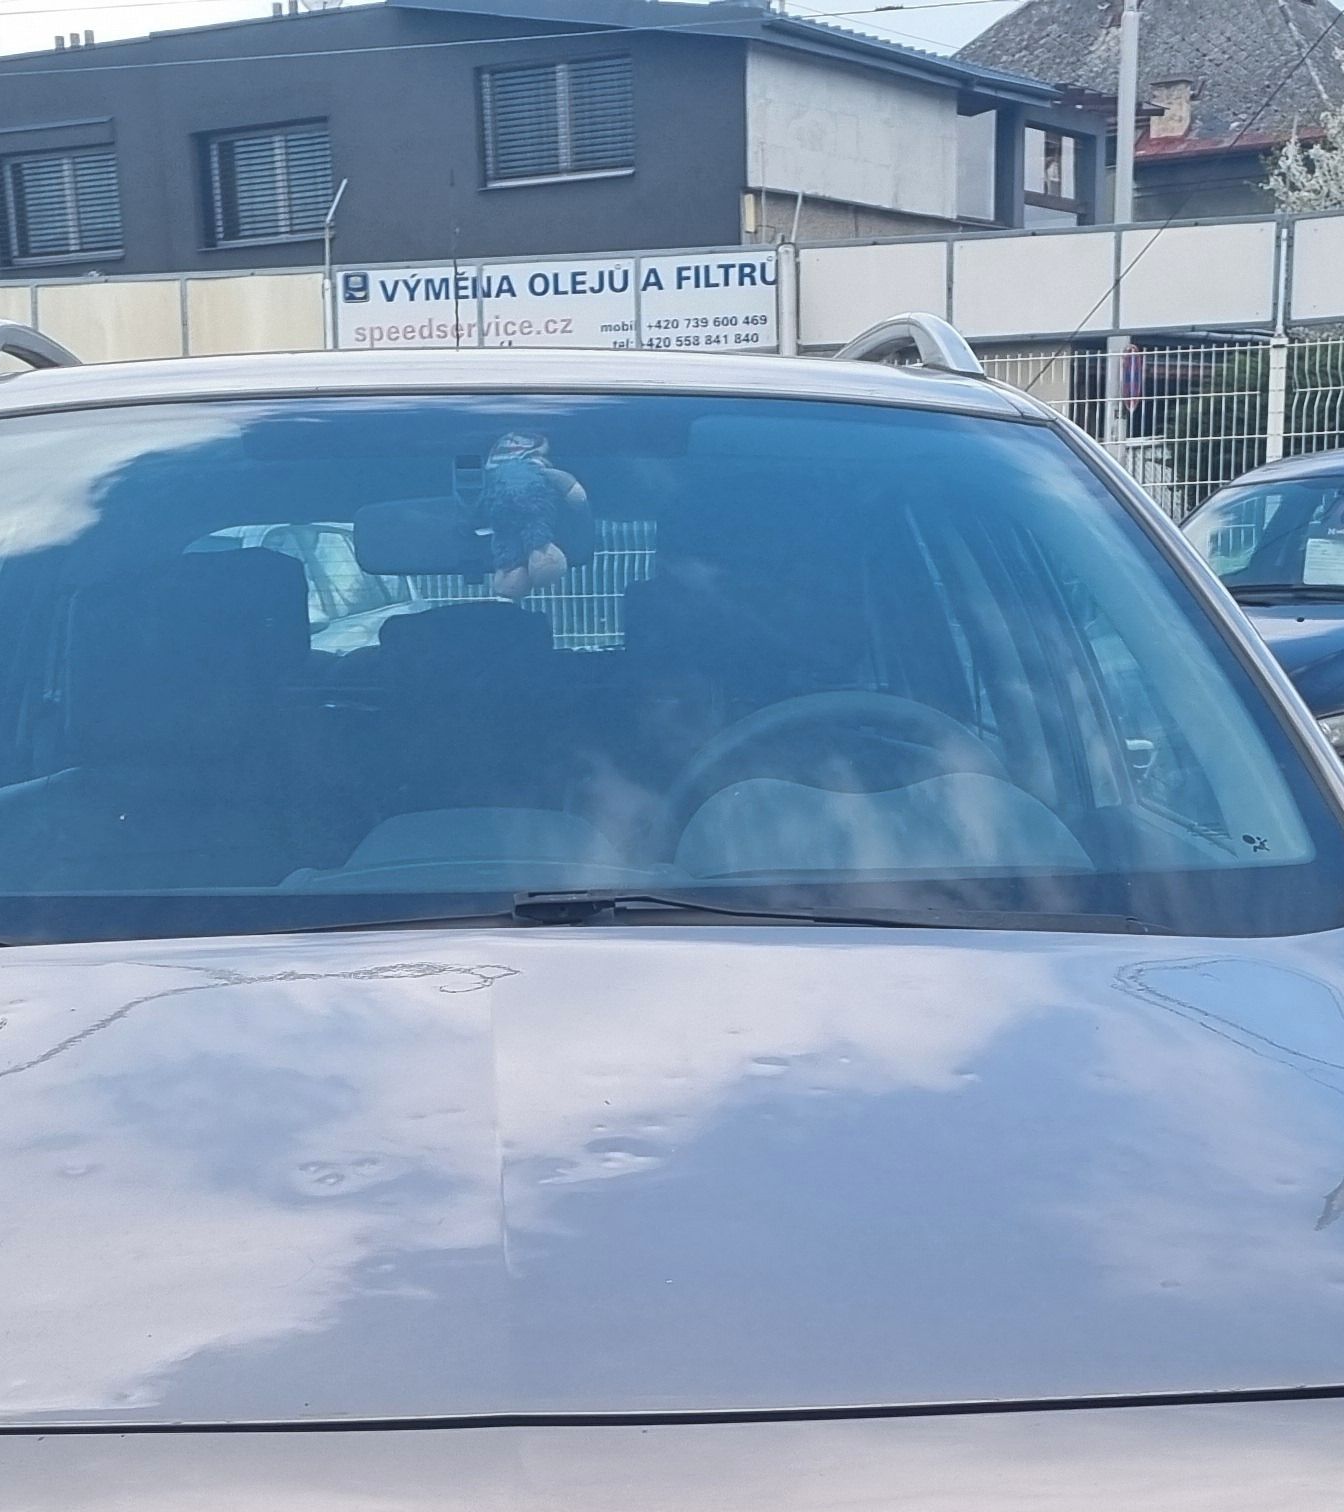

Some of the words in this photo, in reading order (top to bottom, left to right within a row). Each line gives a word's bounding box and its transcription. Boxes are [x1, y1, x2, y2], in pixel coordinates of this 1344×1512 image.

[379, 272, 516, 302] VÝMĚNA
[528, 264, 629, 295] OLEJŮ
[641, 267, 664, 292] A
[675, 255, 778, 290] FILTRŮ
[354, 315, 573, 348] speedservice.cz
[685, 317, 708, 328] 739
[713, 316, 738, 327] 600
[742, 315, 768, 325] 469
[676, 335, 700, 347] 558
[705, 334, 728, 345] 841
[734, 333, 759, 343] 840
